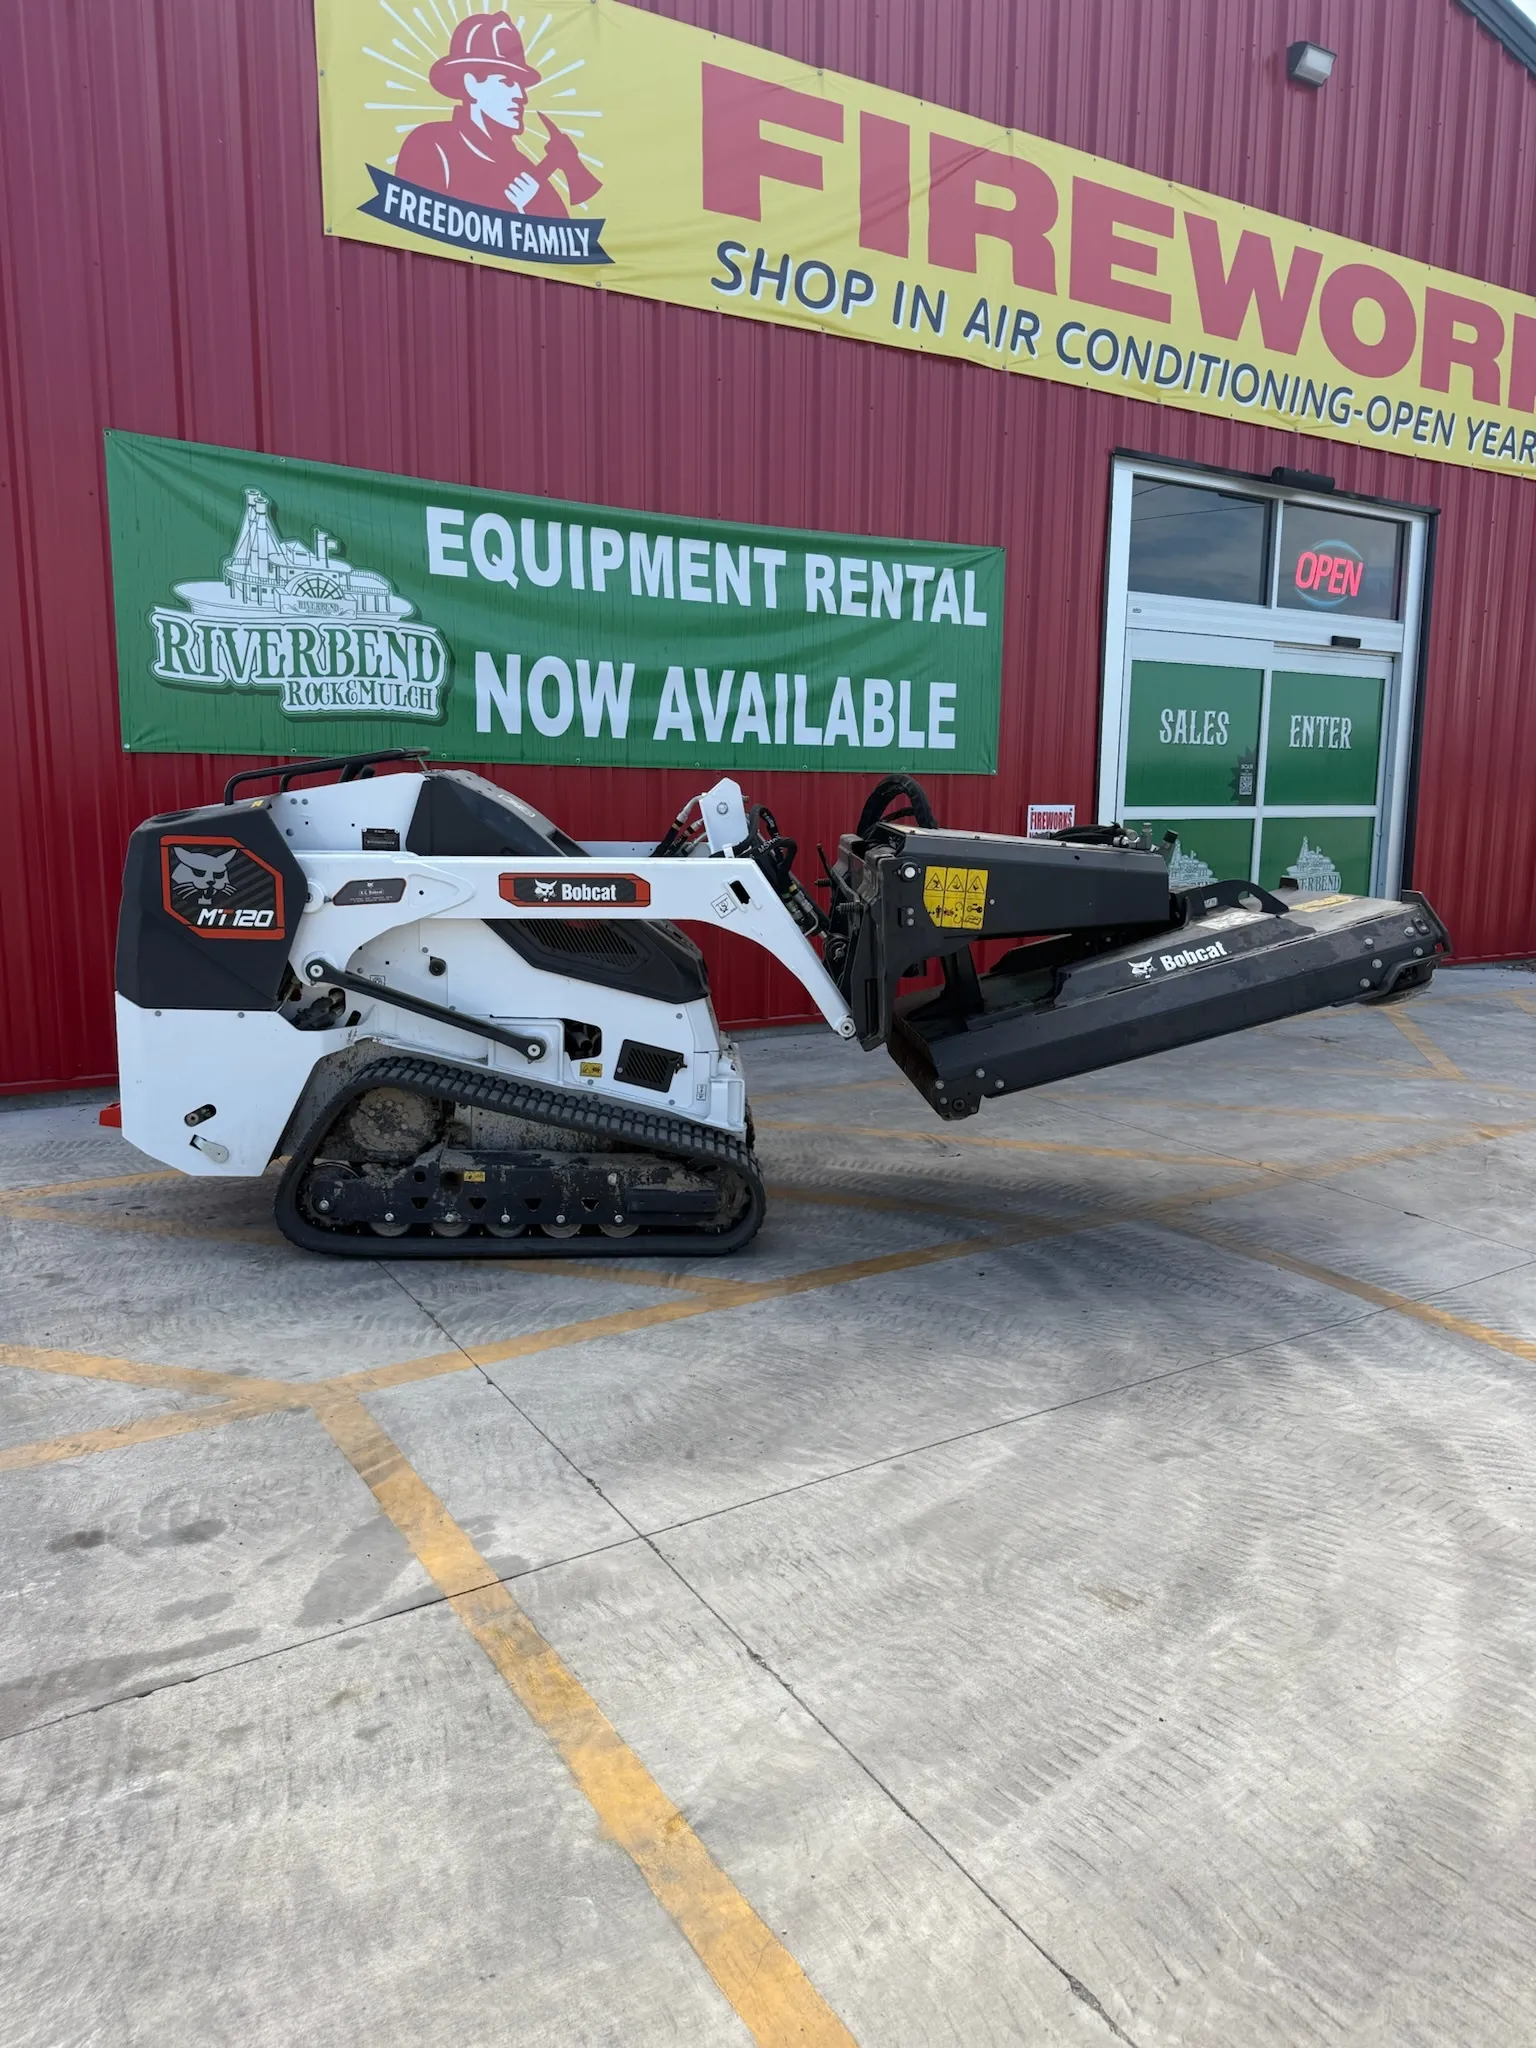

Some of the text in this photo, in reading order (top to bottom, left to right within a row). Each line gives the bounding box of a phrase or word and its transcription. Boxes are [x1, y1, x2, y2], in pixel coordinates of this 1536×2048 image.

[384, 182, 590, 257] FREEDOM FAMILY
[710, 240, 875, 317] SHOP
[893, 280, 946, 334] IN
[963, 297, 1041, 357] AIR
[425, 506, 987, 627] EQUIPMENT RENTAL
[1295, 551, 1364, 597] OPEN
[157, 618, 442, 684] RIVERBEND
[474, 650, 957, 750] NOW AVAILABLE
[1159, 708, 1230, 746] SALES
[1288, 714, 1353, 750] ENTER
[1030, 811, 1073, 830] FIREWORKS
[561, 883, 617, 901] Bobcat
[1160, 941, 1228, 972] Bobcat
